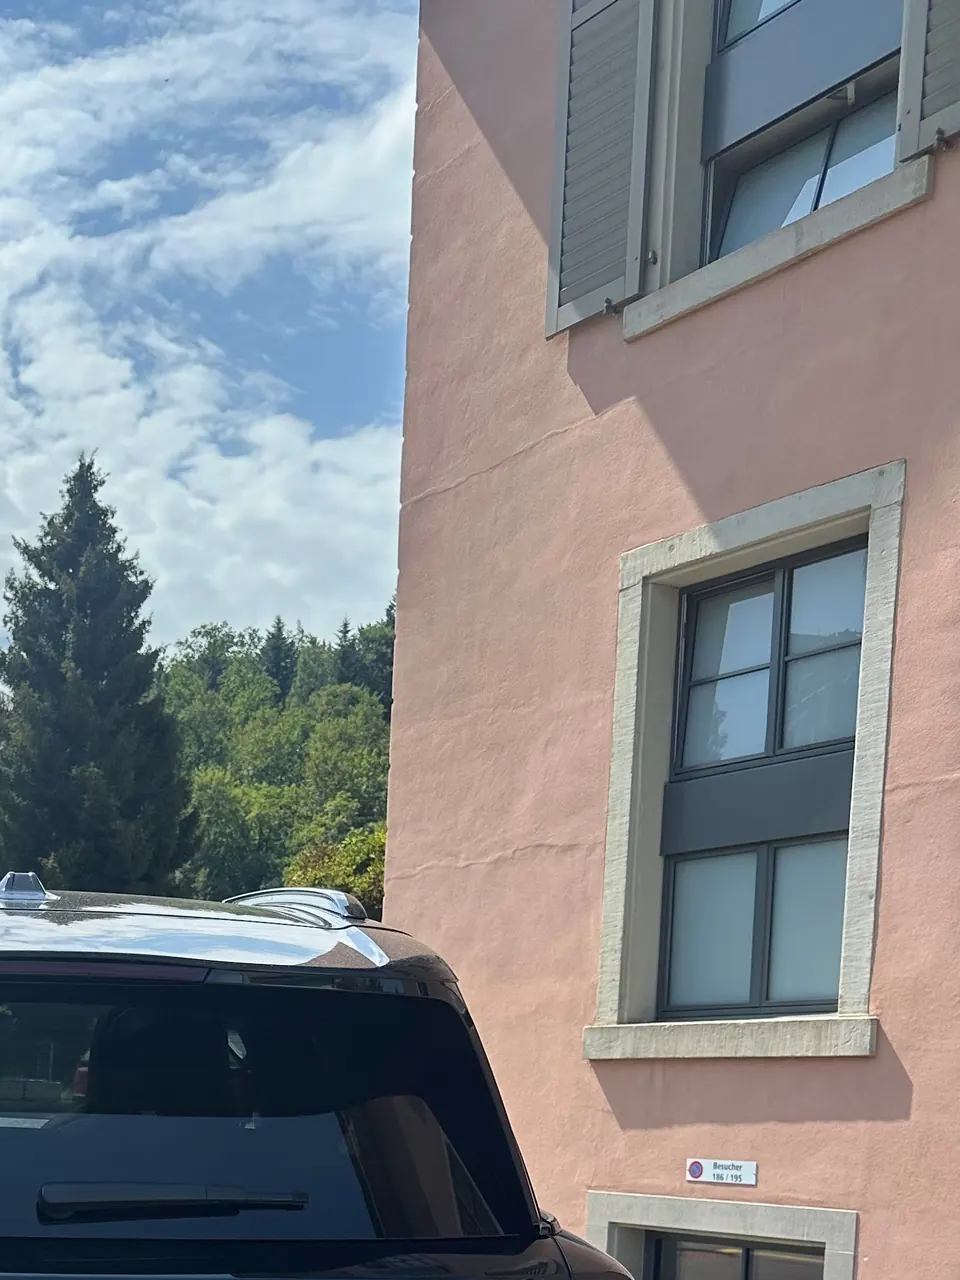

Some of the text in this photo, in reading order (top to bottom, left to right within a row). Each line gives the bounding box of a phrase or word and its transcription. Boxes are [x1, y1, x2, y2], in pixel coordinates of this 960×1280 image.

[713, 1162, 742, 1171] Besucher
[713, 1173, 724, 1181] 186
[730, 1174, 742, 1182] 195
